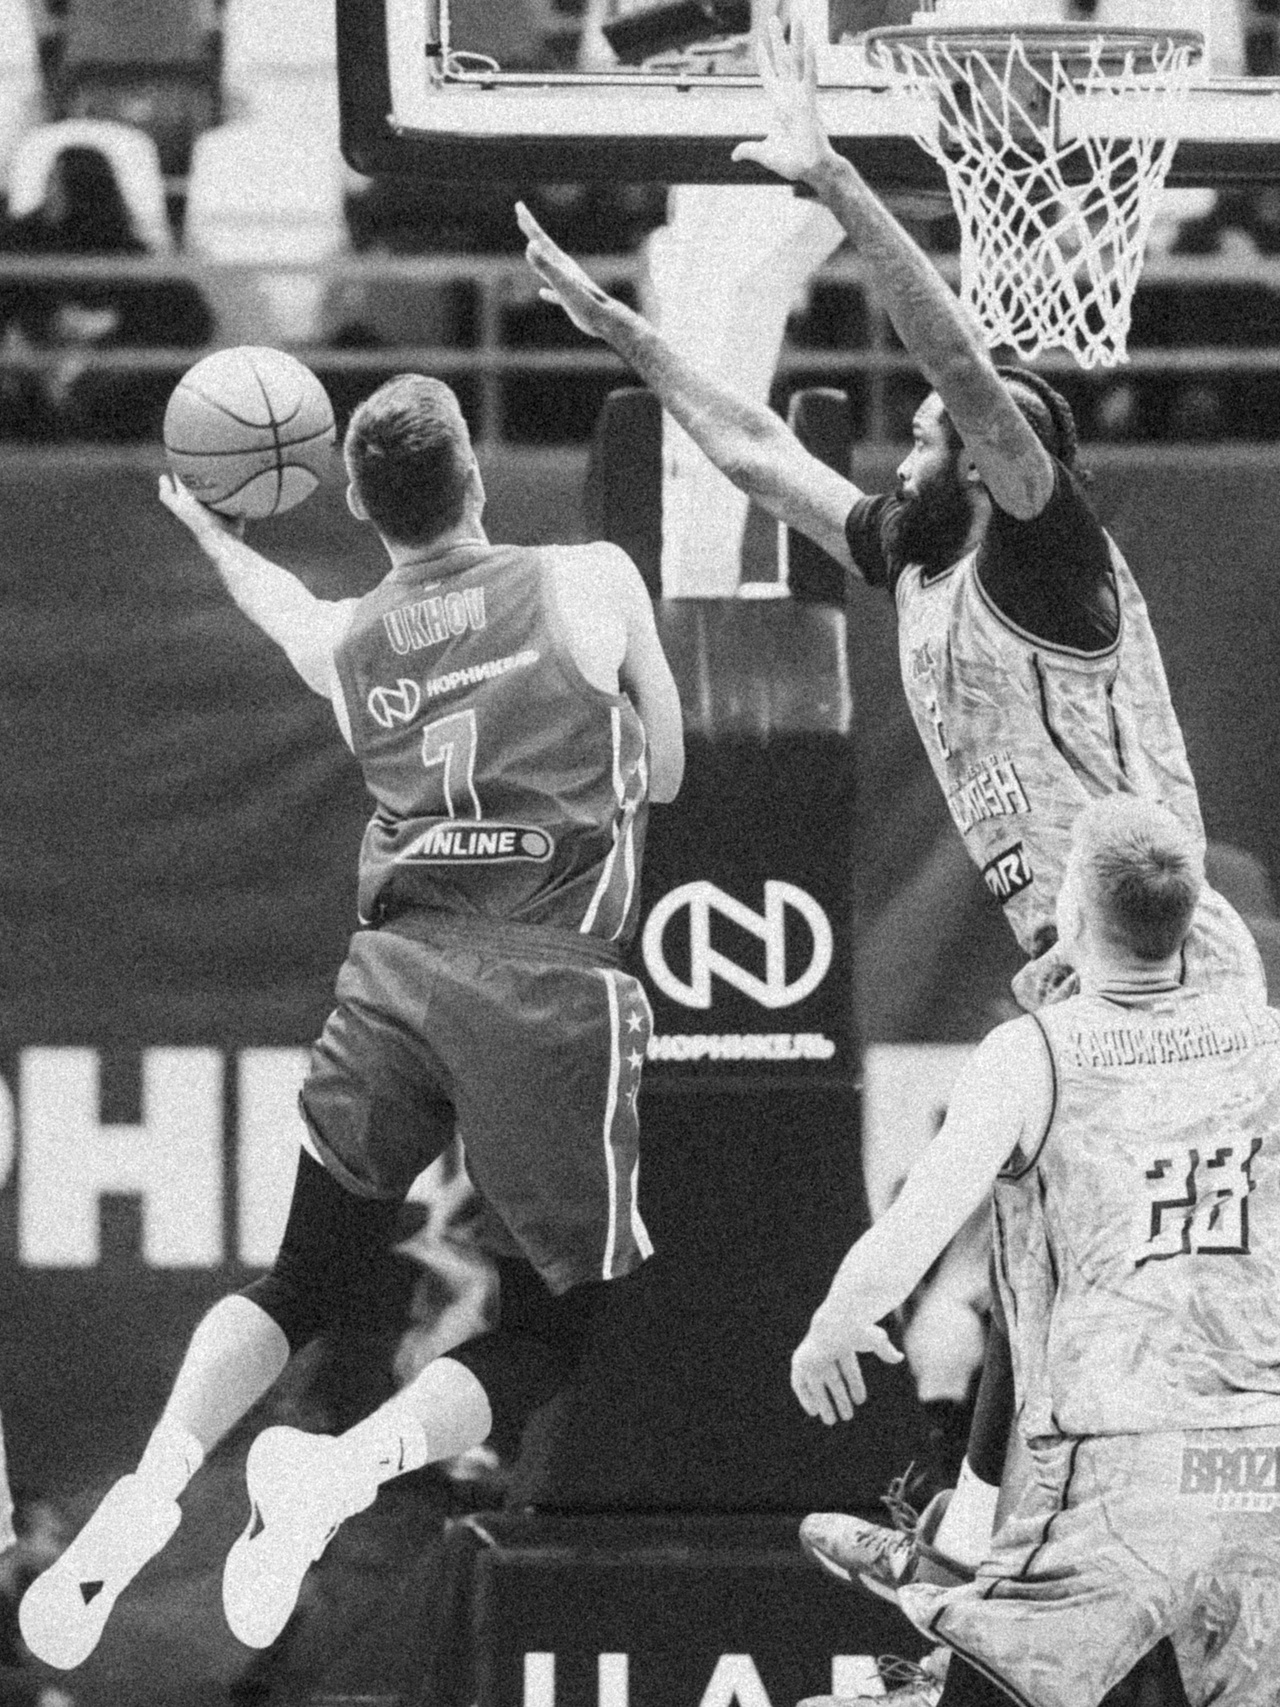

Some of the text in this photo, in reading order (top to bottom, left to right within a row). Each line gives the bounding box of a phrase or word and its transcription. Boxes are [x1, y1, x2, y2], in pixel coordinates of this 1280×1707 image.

[382, 585, 487, 655] UKHOV
[421, 708, 482, 822] 7
[416, 831, 517, 856] INLINE
